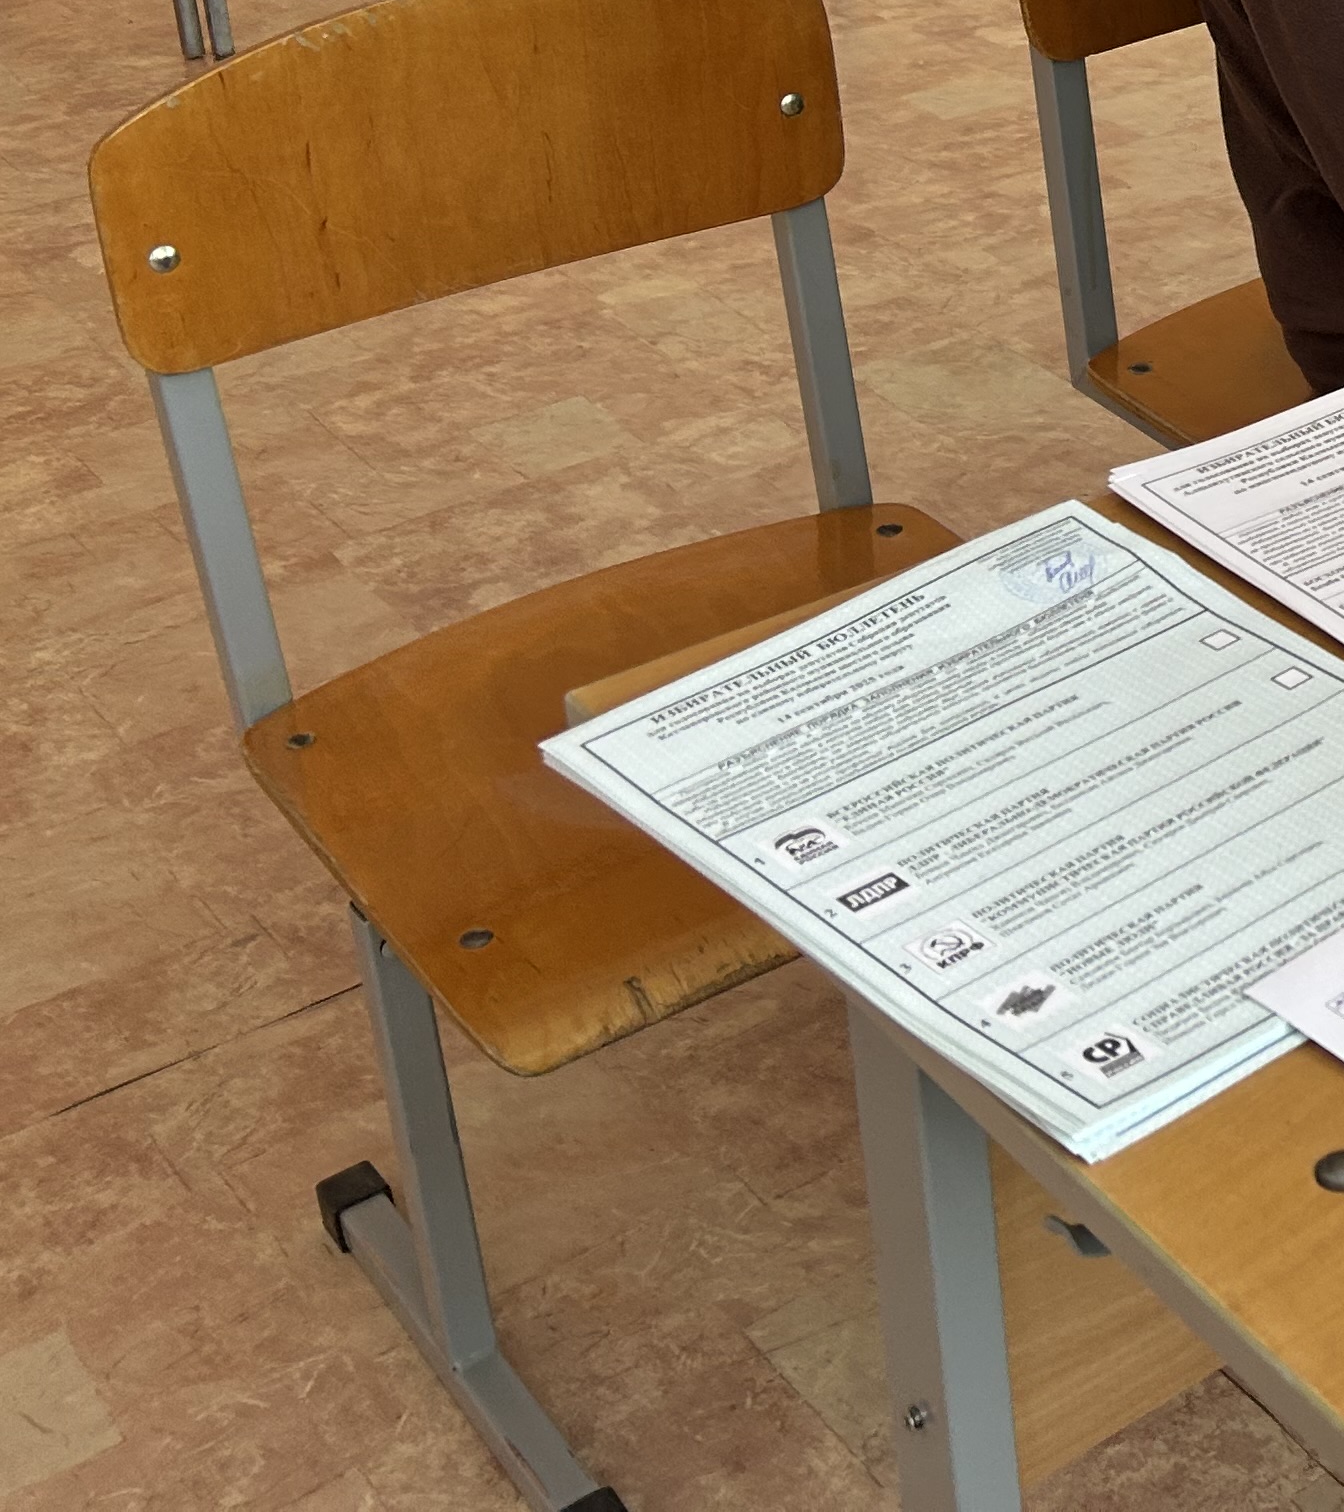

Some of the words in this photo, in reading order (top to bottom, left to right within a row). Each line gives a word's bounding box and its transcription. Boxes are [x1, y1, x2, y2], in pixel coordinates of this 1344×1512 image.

[1196, 421, 1326, 474] ИЗБИРАТЕЛЬНЫЙ
[1298, 477, 1316, 487] 14
[648, 648, 813, 724] ИЗБИРАТЕЛЬНЫЙ
[815, 592, 927, 651] БЮЛЛЕТЕНЬ
[775, 714, 793, 723] 14
[791, 688, 849, 716] сентября
[845, 675, 877, 691] 2025
[875, 664, 904, 678] года
[848, 875, 899, 908] ЛДПР
[937, 942, 984, 968] КПРФ
[1082, 1038, 1121, 1063] СР
